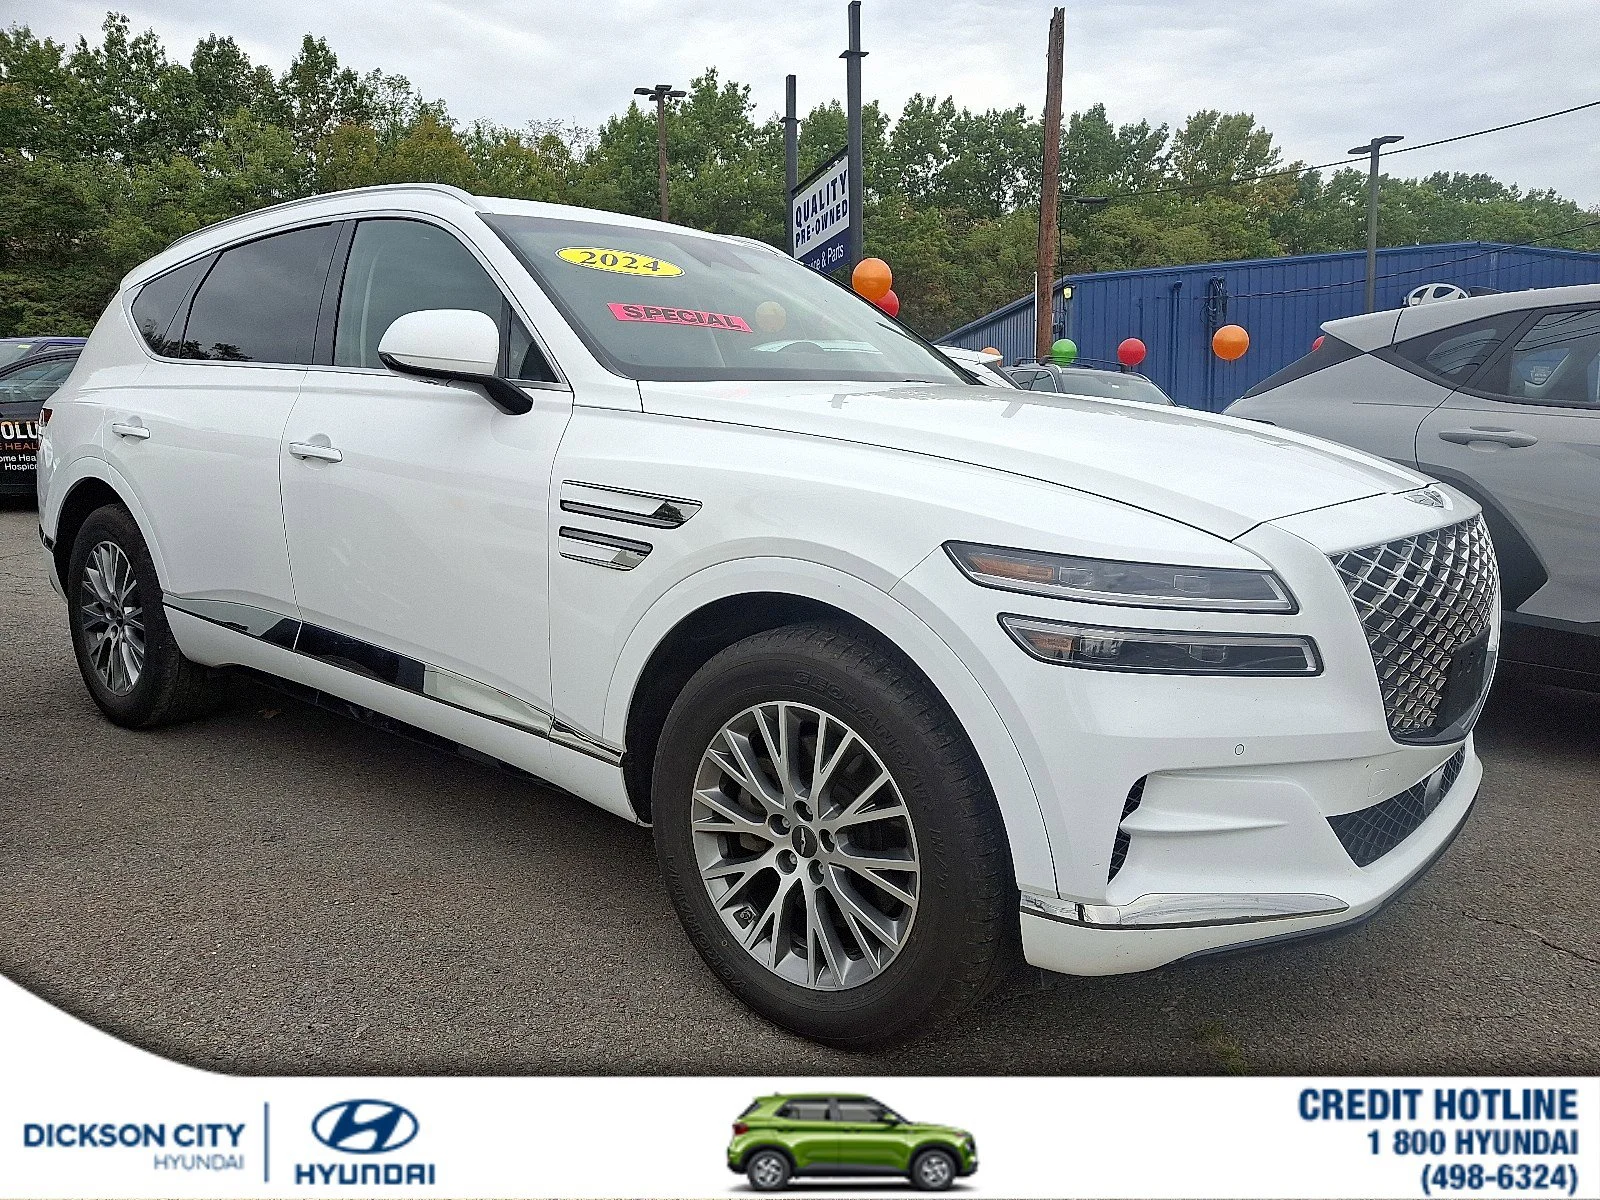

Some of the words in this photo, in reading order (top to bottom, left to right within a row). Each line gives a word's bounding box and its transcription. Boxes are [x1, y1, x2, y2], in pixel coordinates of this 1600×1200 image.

[795, 169, 848, 228] QUALITY
[795, 199, 848, 248] PRE-OWNED
[580, 251, 661, 272] 2024
[821, 251, 827, 268] &
[827, 243, 844, 264] Parts
[622, 305, 742, 330] SPECIAL
